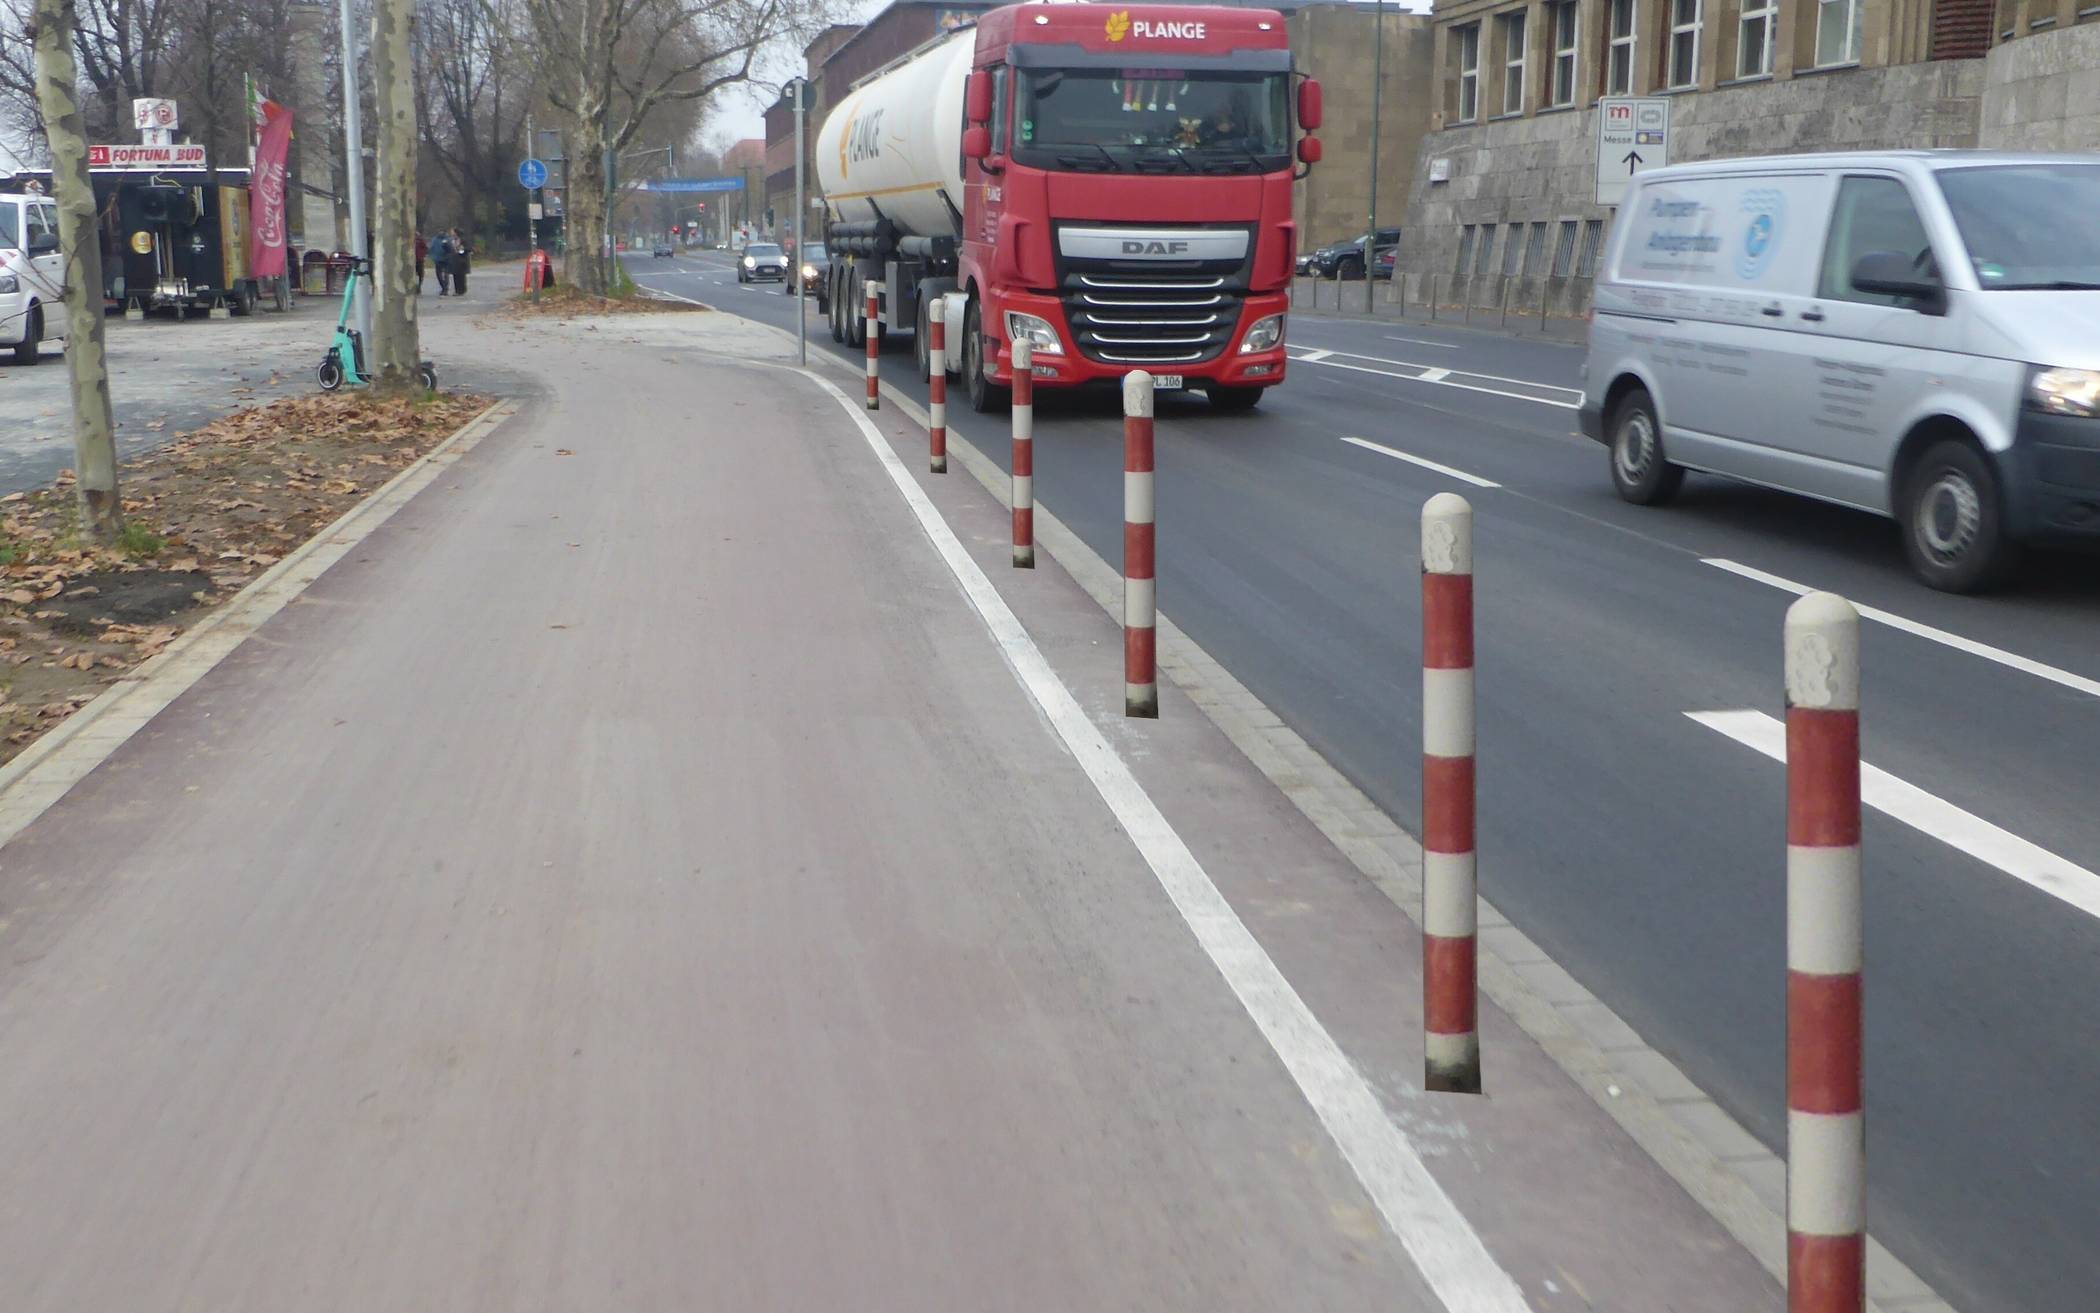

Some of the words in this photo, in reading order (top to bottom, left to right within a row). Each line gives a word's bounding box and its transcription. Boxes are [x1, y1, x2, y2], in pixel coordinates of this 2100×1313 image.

[1133, 21, 1206, 39] PLANGE
[848, 107, 885, 163] PLANGE
[1603, 135, 1633, 145] Messe
[111, 148, 171, 162] FORTUNA
[175, 147, 204, 161] BUD
[1121, 241, 1188, 255] DAF
[1164, 376, 1181, 388] 106
